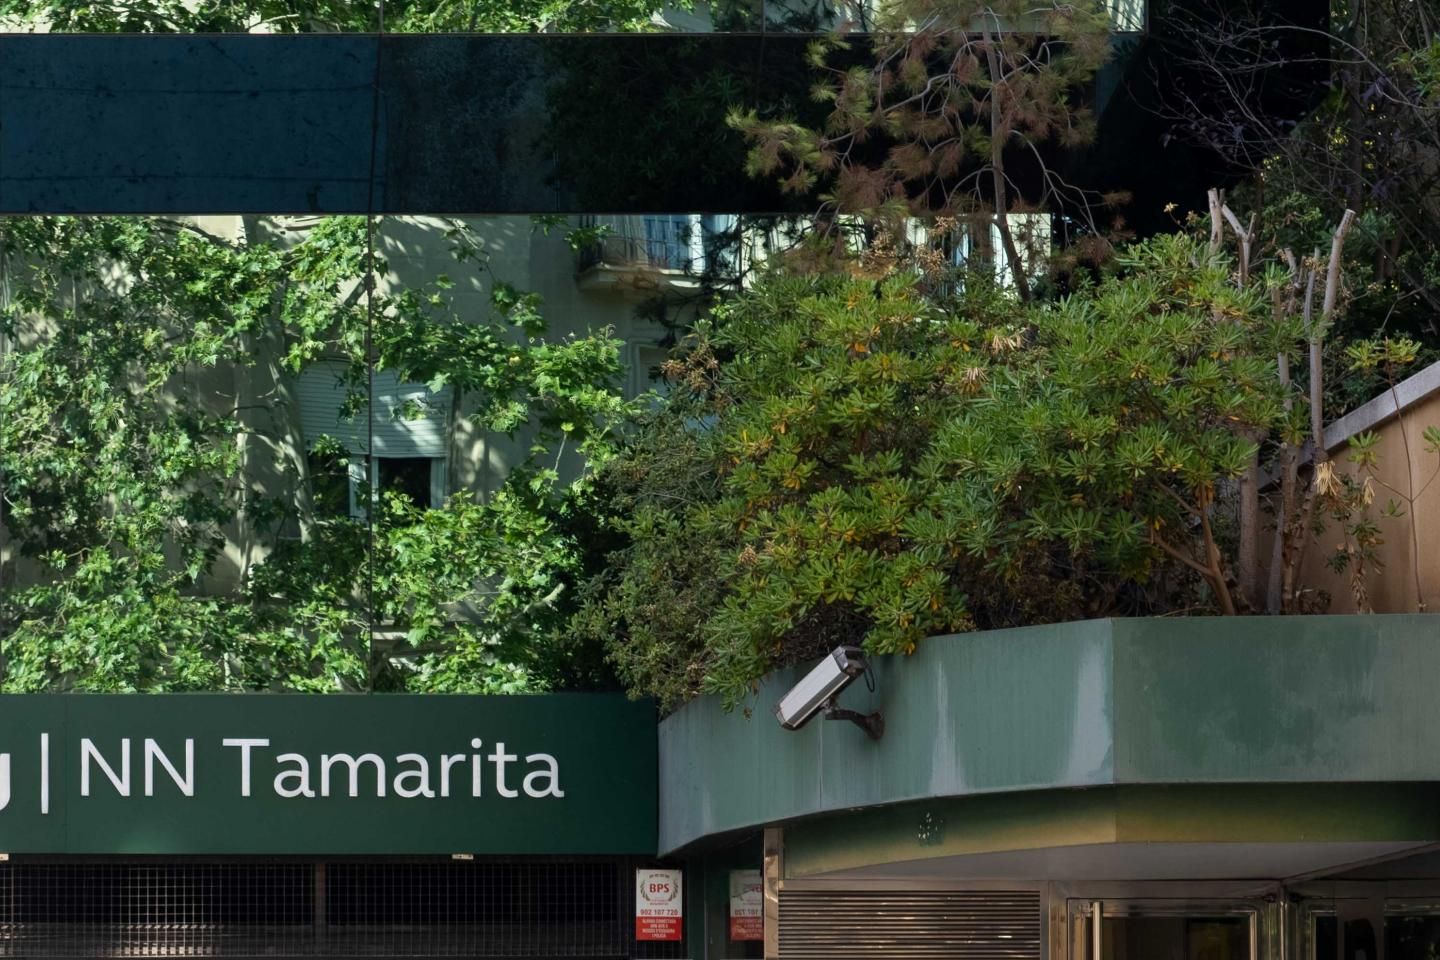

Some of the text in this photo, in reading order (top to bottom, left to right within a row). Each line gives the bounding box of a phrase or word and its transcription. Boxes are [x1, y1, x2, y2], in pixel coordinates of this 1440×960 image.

[82, 739, 194, 797] NN
[223, 738, 563, 798] Tamarita
[649, 883, 670, 893] BPS
